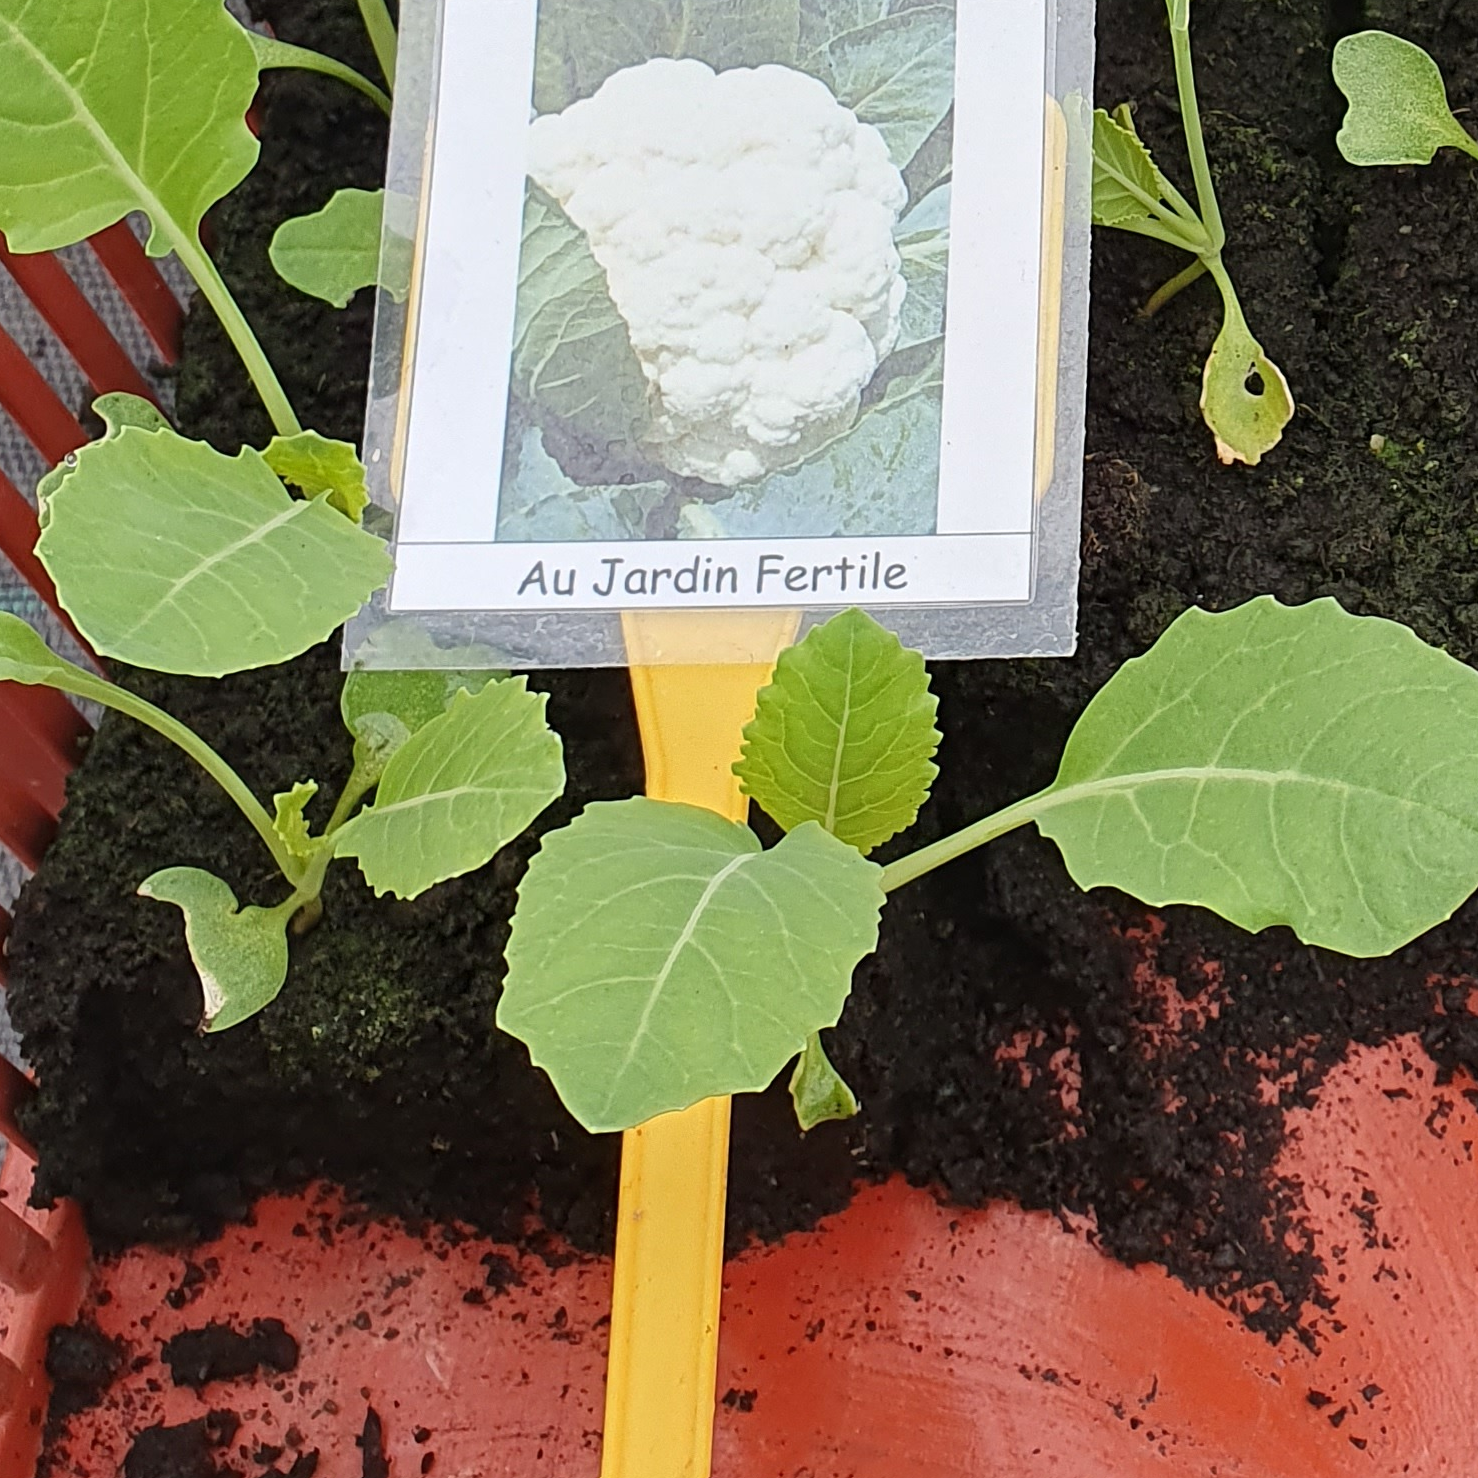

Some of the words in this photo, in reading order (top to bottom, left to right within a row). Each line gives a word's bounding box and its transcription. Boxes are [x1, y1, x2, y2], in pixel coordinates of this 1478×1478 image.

[516, 559, 577, 597] Au
[592, 554, 739, 597] Jardin
[755, 550, 909, 595] Fertile
